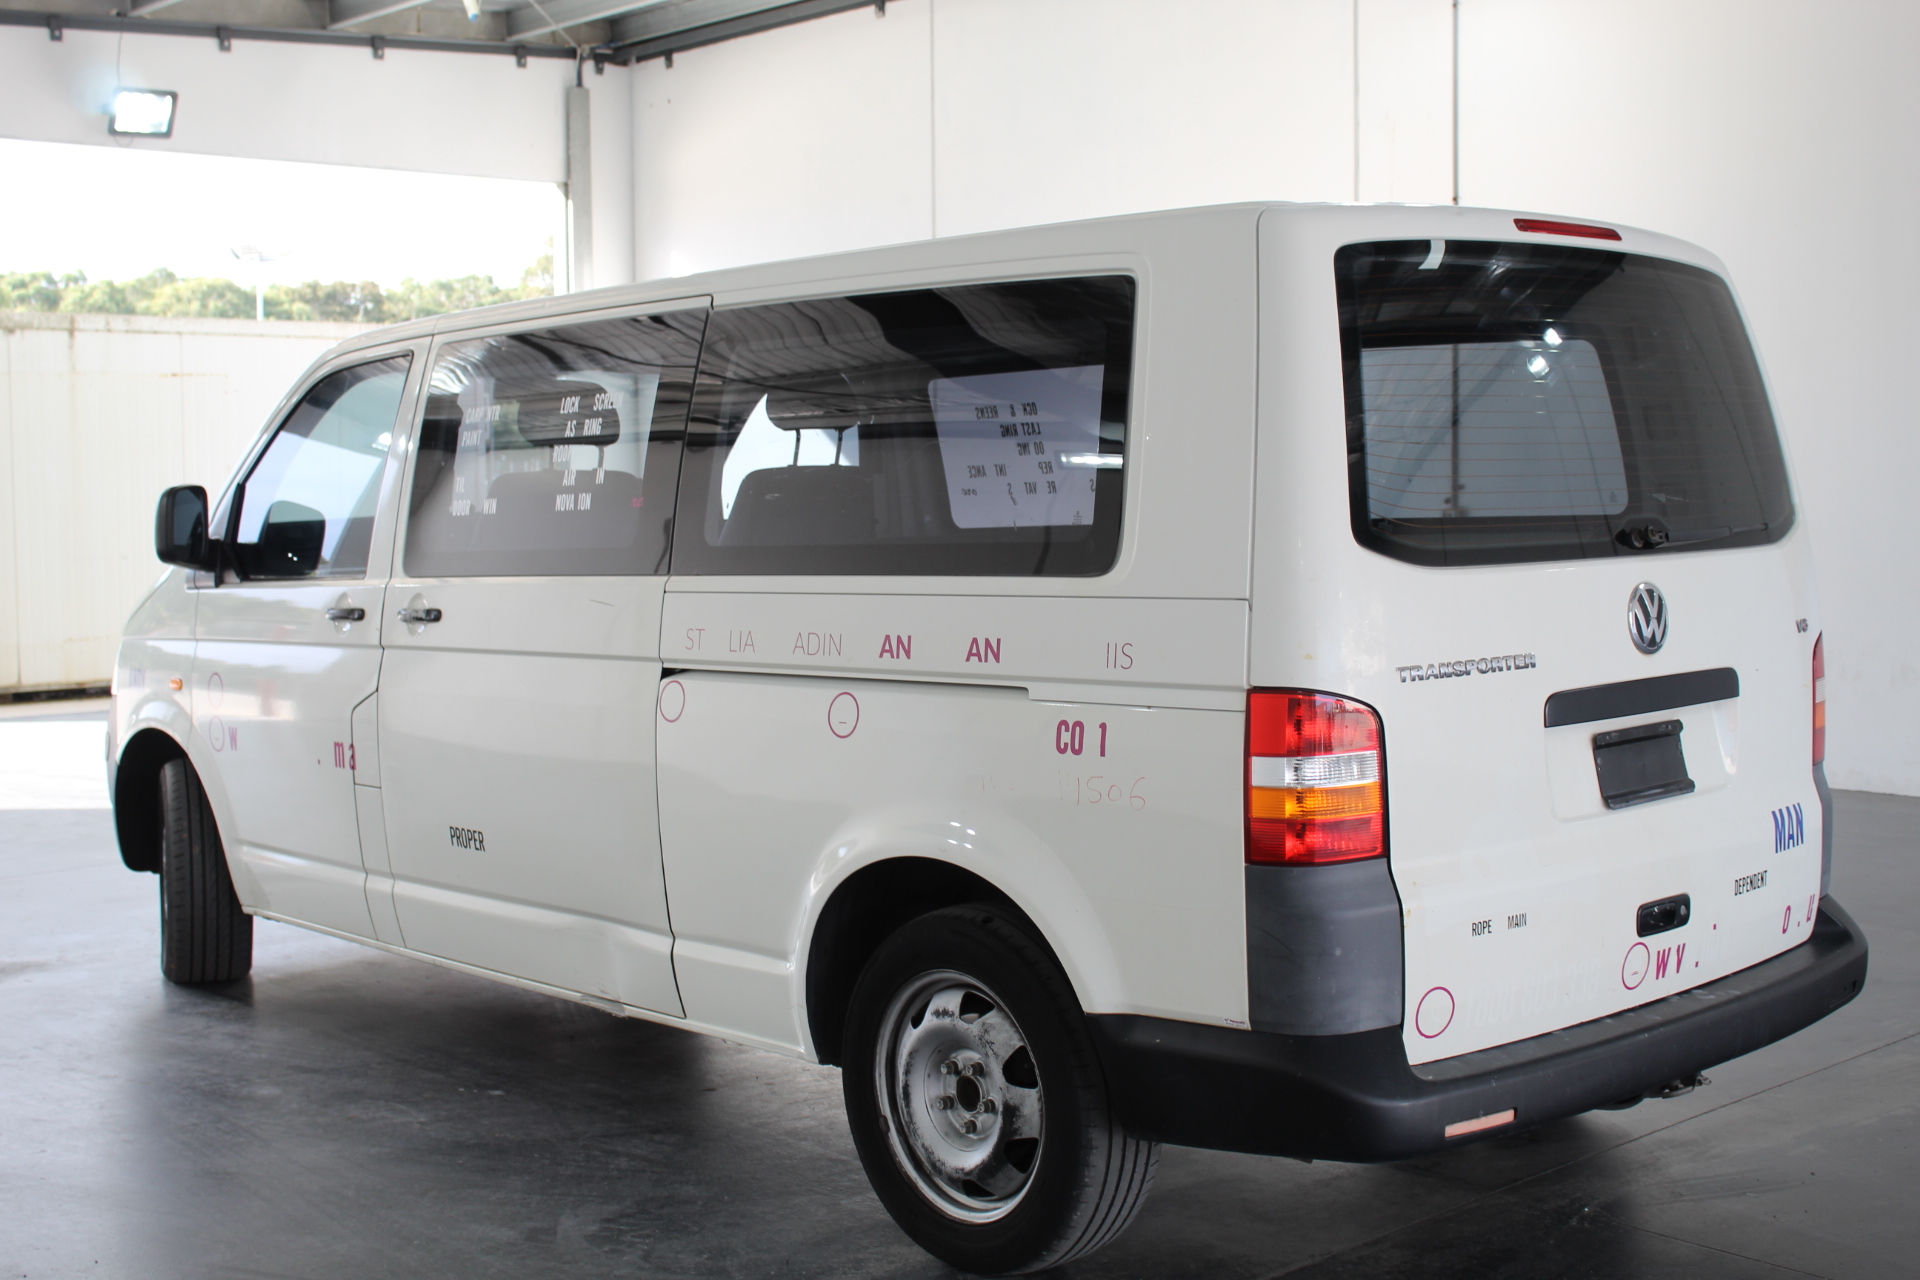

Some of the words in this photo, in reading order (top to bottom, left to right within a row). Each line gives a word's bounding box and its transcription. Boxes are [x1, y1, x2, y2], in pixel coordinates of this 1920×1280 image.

[559, 395, 581, 415] LOCK
[583, 417, 604, 436] RING
[562, 469, 577, 487] AIR
[684, 627, 706, 651] ST
[728, 629, 756, 654] LIA
[792, 631, 843, 657] ADIN
[879, 634, 912, 660] AN
[965, 636, 1002, 664] AN
[1395, 652, 1537, 684] TRANSPORTER
[449, 825, 486, 852] PROPER
[1771, 802, 1804, 854] MAN
[1734, 869, 1768, 896] DEPENDENT
[1472, 919, 1493, 938] ROPE
[1508, 912, 1527, 930] MAIN
